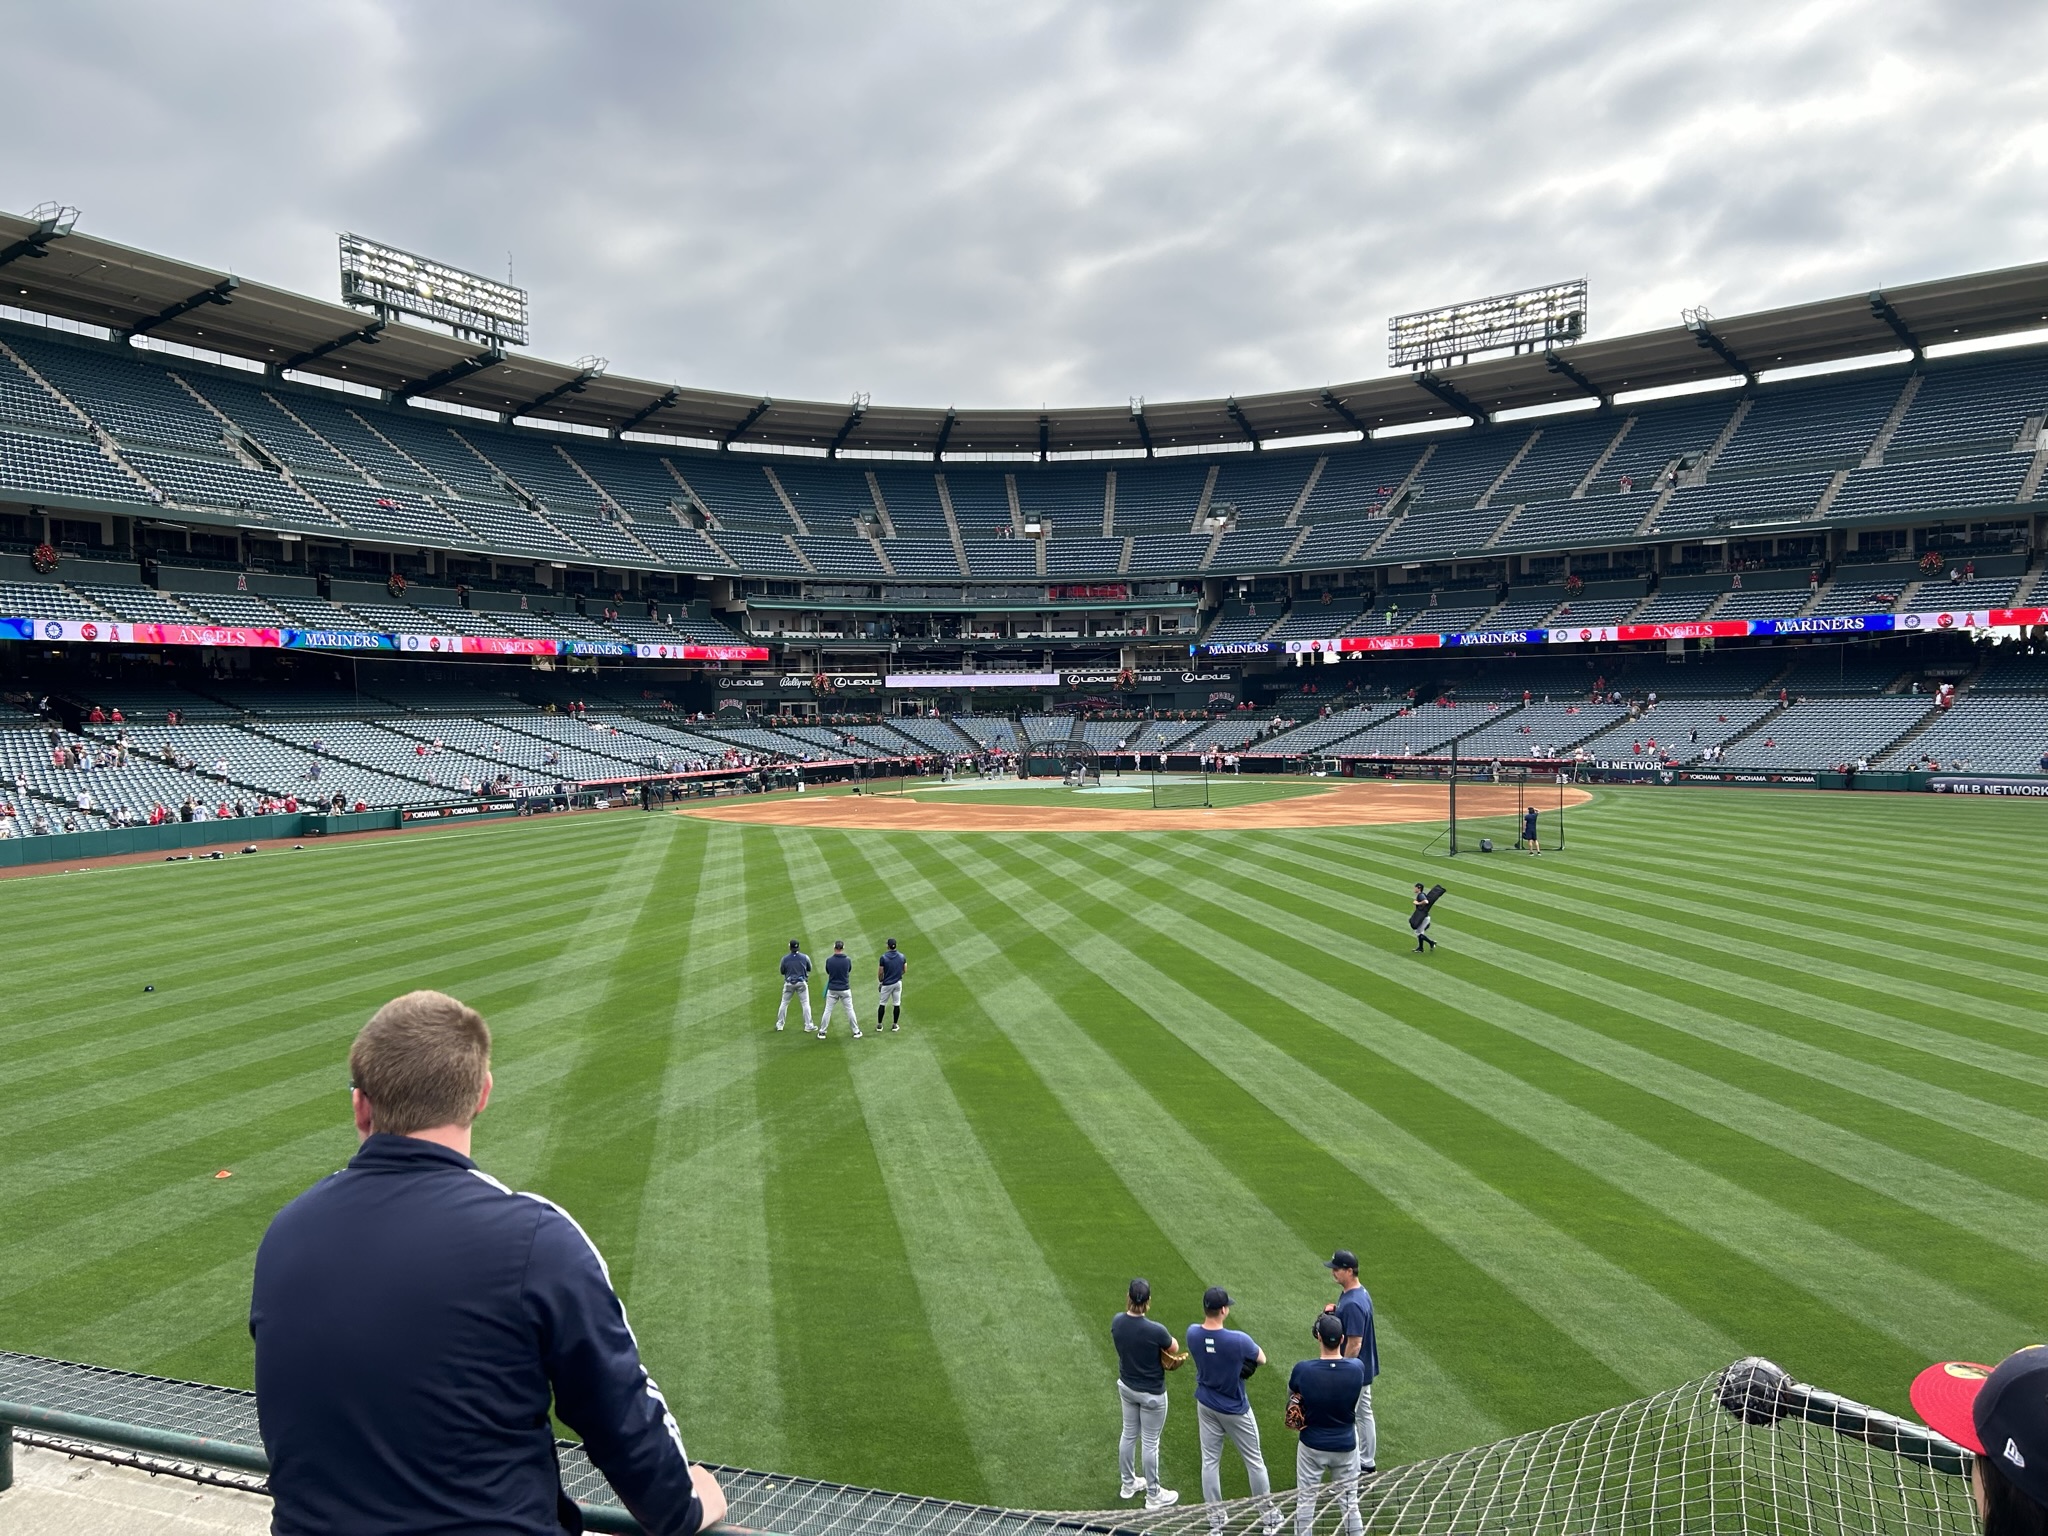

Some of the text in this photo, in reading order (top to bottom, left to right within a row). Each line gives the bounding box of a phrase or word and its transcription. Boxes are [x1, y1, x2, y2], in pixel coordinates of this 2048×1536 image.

[1774, 617, 1865, 634] MARINERS
[1938, 616, 1953, 626] VS
[82, 627, 97, 637] VS
[177, 627, 247, 645] ANGELS
[1652, 624, 1714, 638] ANGELS
[304, 632, 380, 649] MARINERS
[1367, 637, 1415, 650] ANGELS
[1459, 631, 1527, 646] MARINERS
[490, 640, 534, 653] ANGELS
[572, 643, 623, 656] MARINERS
[1208, 642, 1270, 656] MARINERS
[705, 648, 748, 660] ANGELS
[731, 679, 764, 687] LEXUS
[847, 678, 882, 686] LEXUS
[1081, 676, 1117, 684] LEXUS
[1194, 673, 1231, 681] LEXUS
[1208, 691, 1235, 704] ANGELS
[719, 698, 743, 712] ANGELS
[508, 784, 556, 799] NETWORK
[1953, 784, 2048, 796] MLB NETWORK
[450, 806, 479, 815] YOKOHAMA
[488, 802, 515, 811] YOKOHAMA
[411, 810, 441, 819] YOKOHAMA
